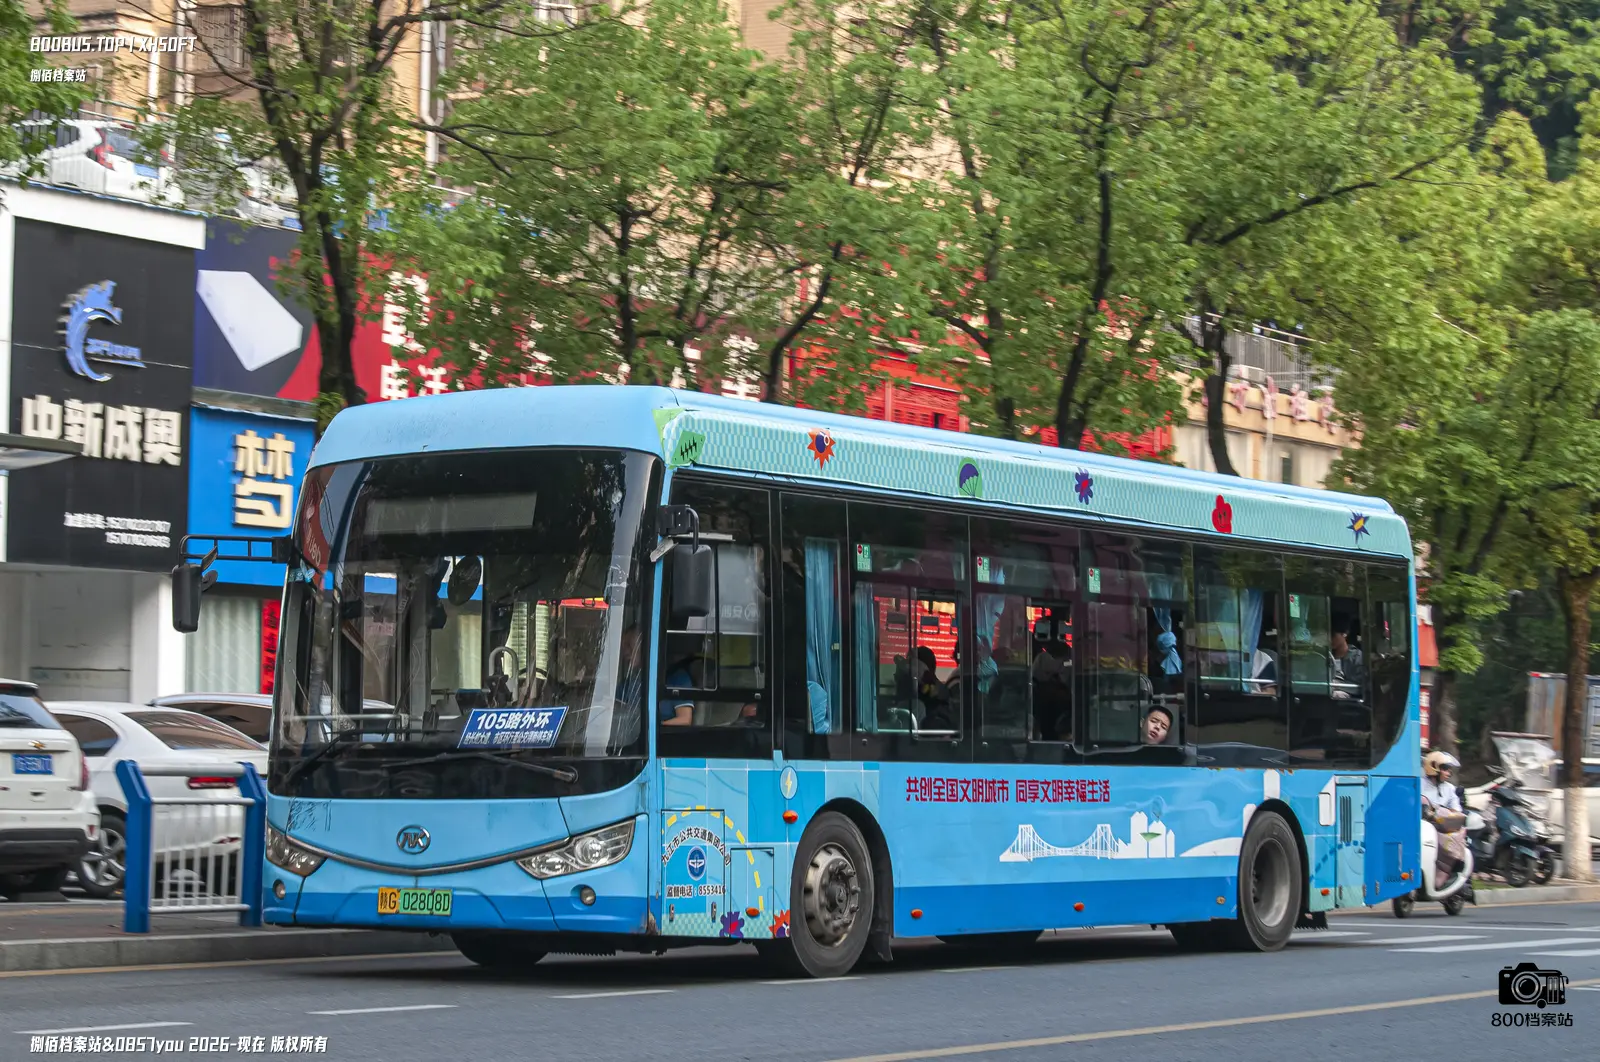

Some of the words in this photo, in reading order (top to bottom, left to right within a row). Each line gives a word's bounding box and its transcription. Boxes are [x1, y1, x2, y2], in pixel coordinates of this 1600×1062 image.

[477, 711, 552, 730] 105路外环
[906, 776, 1009, 803] 共创全国文明城市
[1015, 779, 1111, 803] 同享文明幸福生活
